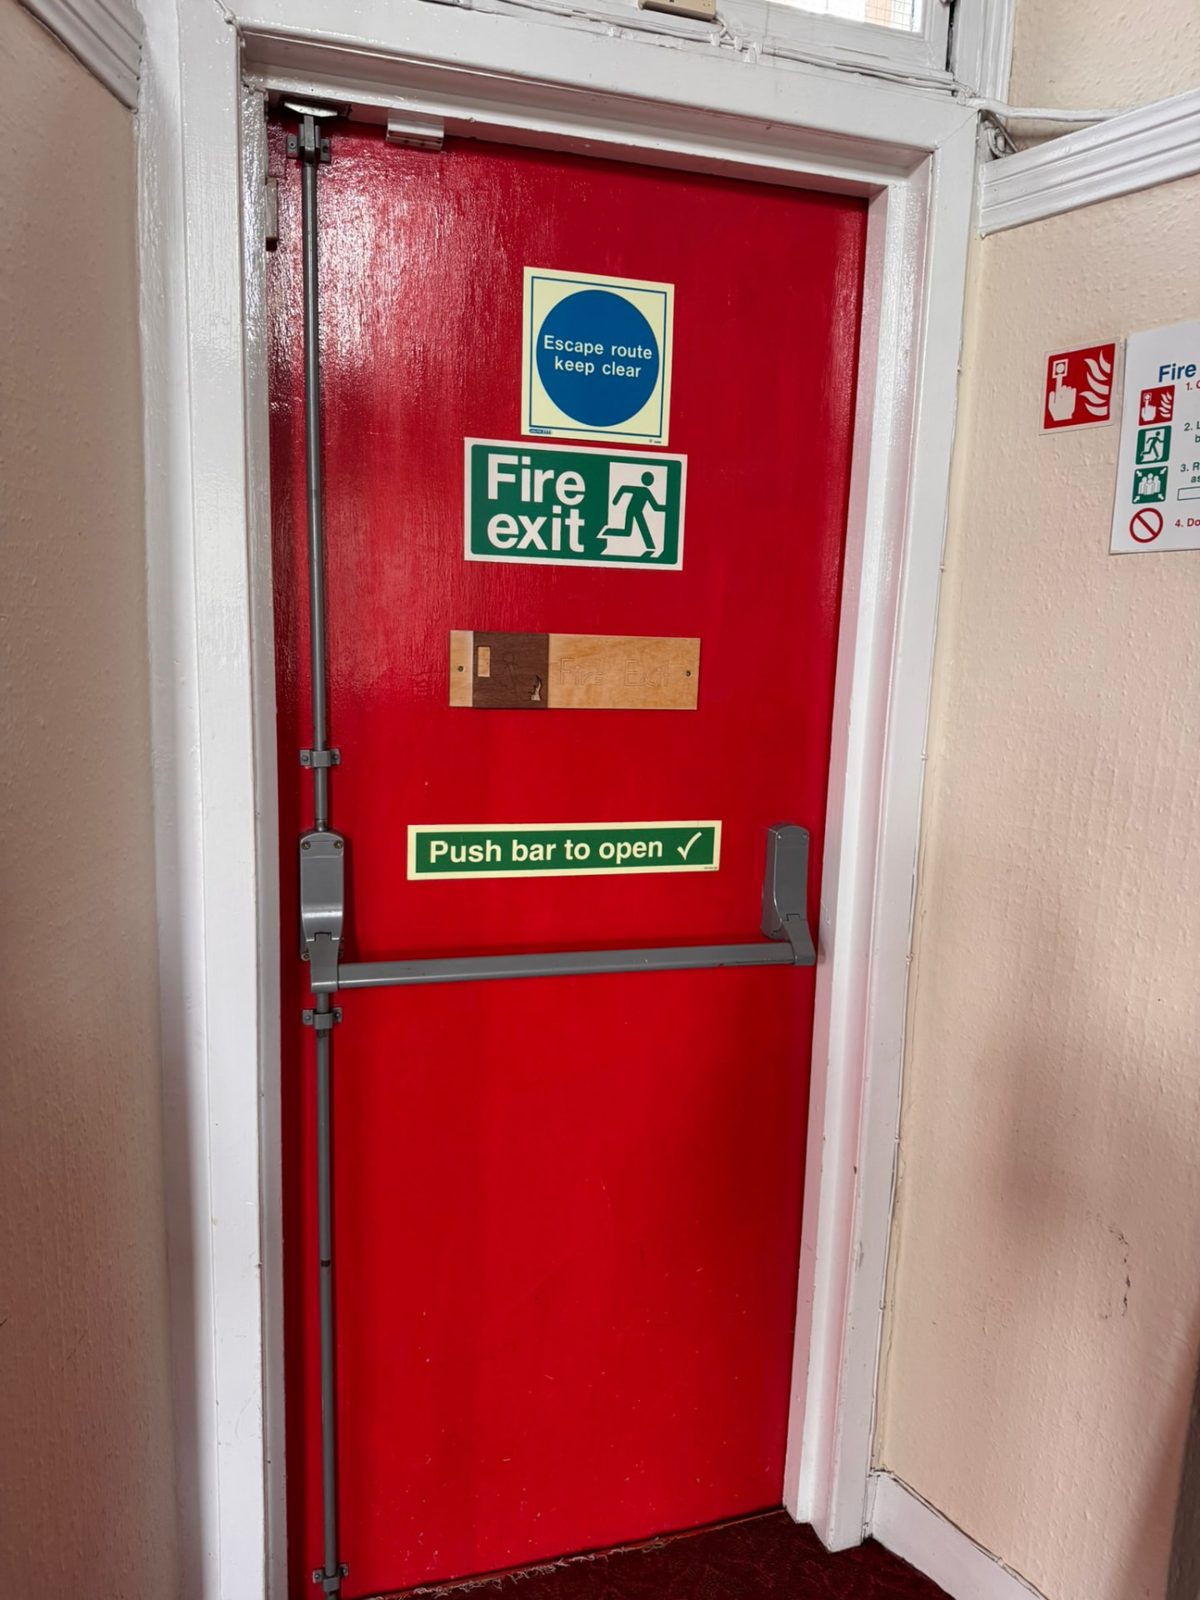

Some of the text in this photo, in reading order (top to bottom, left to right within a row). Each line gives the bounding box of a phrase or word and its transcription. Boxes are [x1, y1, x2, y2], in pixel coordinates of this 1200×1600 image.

[544, 335, 653, 360] Escape route
[554, 356, 641, 378] keep clear
[1158, 363, 1197, 382] Fire
[1186, 382, 1193, 391] 1.
[1184, 422, 1193, 432] 2.
[1180, 463, 1189, 473] 3.
[488, 453, 586, 506] Fire
[487, 505, 586, 553] exit
[1174, 518, 1200, 528] 4. Do
[429, 839, 663, 865] Push bar to open
